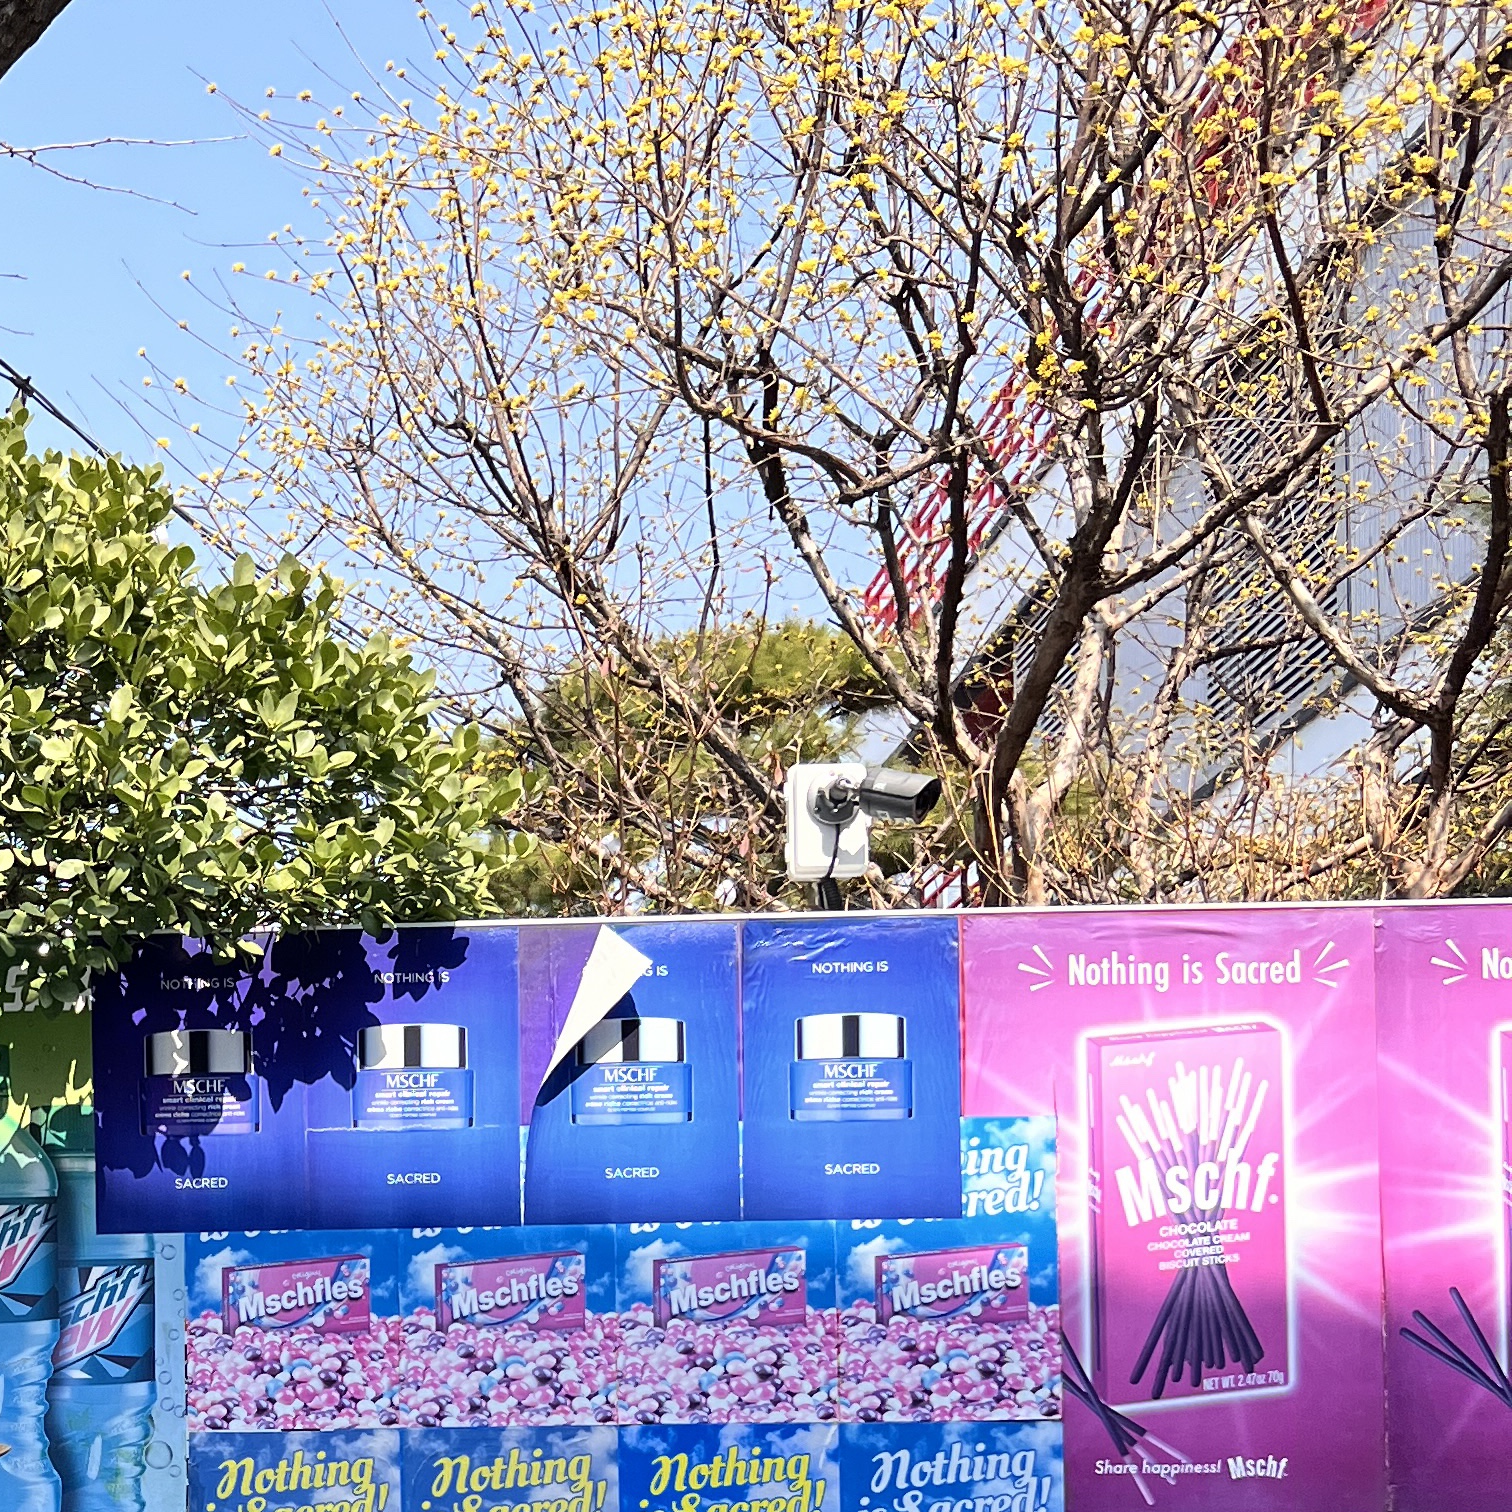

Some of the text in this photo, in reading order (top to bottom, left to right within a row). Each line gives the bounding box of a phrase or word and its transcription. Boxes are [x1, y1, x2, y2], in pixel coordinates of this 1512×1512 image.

[656, 965, 668, 977] IS
[812, 961, 889, 974] NOTHING IS
[1068, 948, 1302, 992] Nothing is Sacred
[374, 971, 449, 984] NOTHING IS
[604, 1068, 658, 1083] MSCHF
[824, 1064, 878, 1079] MSCHF
[173, 1079, 226, 1095] MSCHF
[386, 1073, 439, 1089] MSCHF
[605, 1167, 660, 1179] SACRED
[824, 1163, 880, 1176] SACRED
[175, 1177, 228, 1190] SACRED
[387, 1173, 441, 1186] SACRED
[1159, 1219, 1238, 1238] CHOCOLATE
[1147, 1232, 1251, 1251] CHOCOLATE CREAM
[1174, 1245, 1225, 1259] COVERED
[1158, 1253, 1240, 1271] BISCUIT STICKS
[451, 1272, 580, 1321] Mschfles
[669, 1266, 799, 1318] Mschfles
[891, 1264, 1021, 1315] Mschfles
[238, 1275, 364, 1323] Mschfles
[1203, 1376, 1219, 1391] NET
[217, 1449, 374, 1500] Nothing
[431, 1447, 592, 1500] Nothing
[649, 1445, 812, 1499] Nothing
[869, 1444, 1037, 1498] Nothing
[1094, 1459, 1138, 1475] Share
[1142, 1459, 1222, 1479] happiness!
